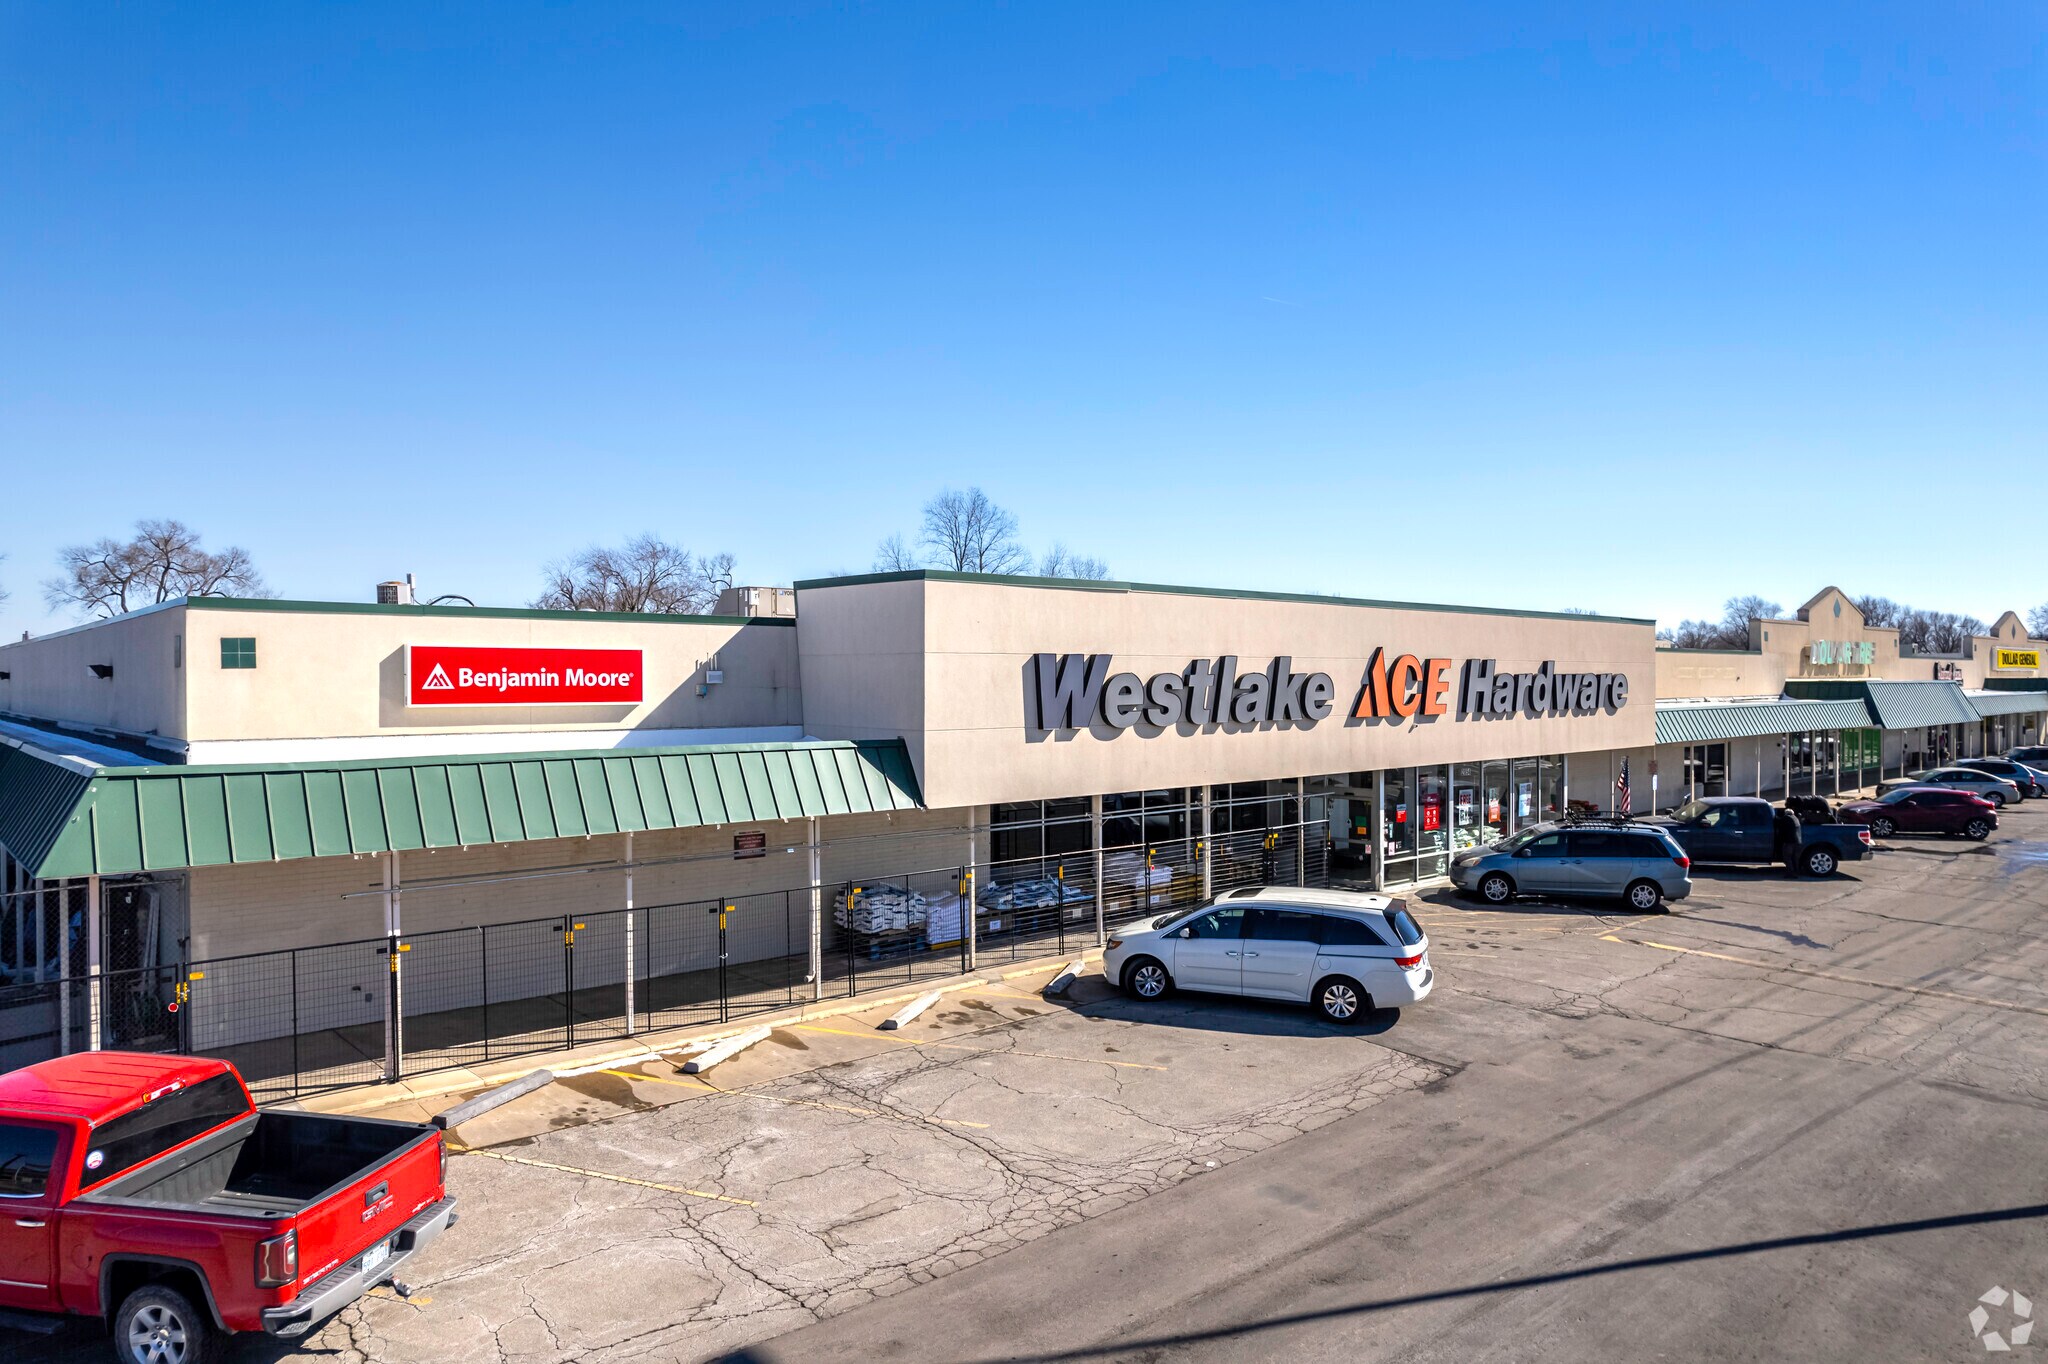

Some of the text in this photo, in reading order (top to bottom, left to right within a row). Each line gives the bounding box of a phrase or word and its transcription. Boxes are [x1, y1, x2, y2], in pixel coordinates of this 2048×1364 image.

[2002, 653, 2036, 665] DOLLAR GENERAL
[458, 667, 559, 692] Benjamin
[1032, 646, 1629, 730] Westlake ACE Hardware
[361, 1195, 394, 1223] GMC
